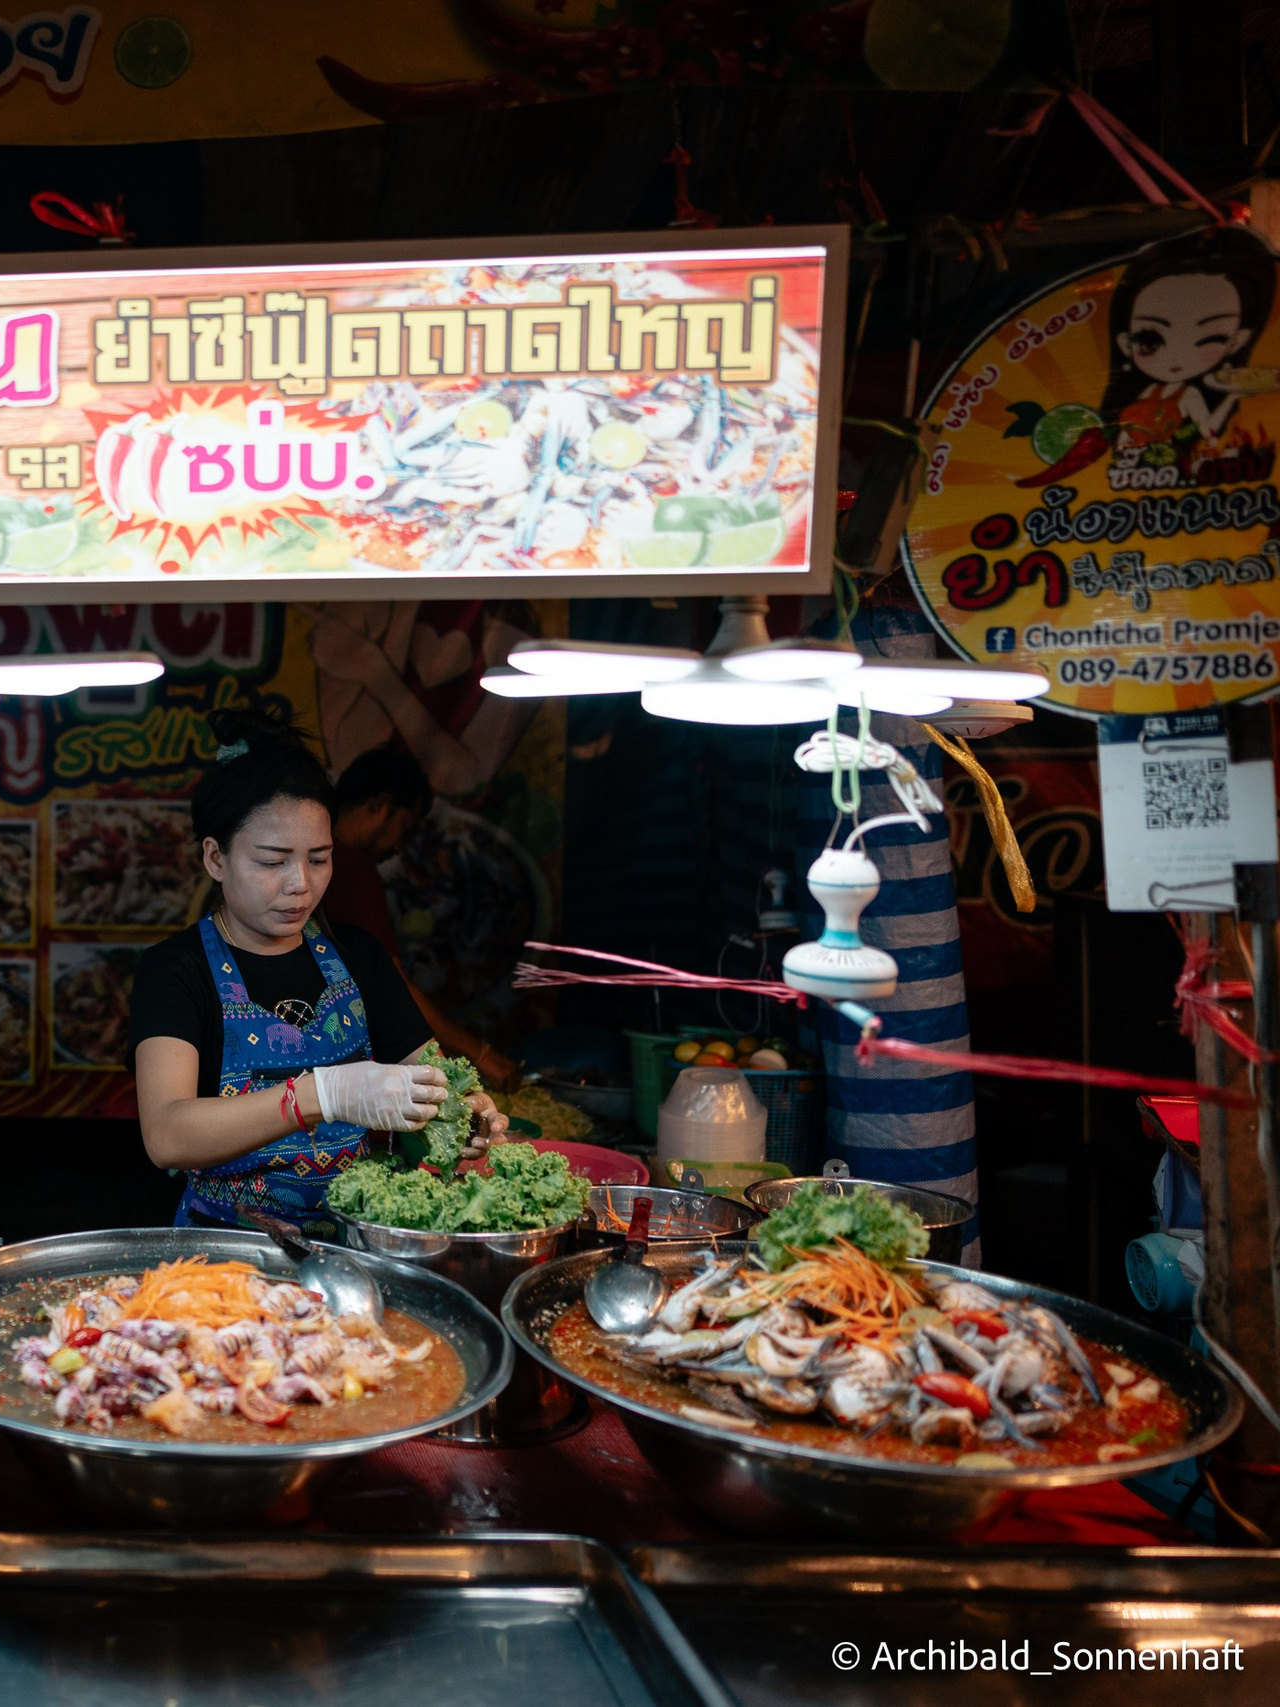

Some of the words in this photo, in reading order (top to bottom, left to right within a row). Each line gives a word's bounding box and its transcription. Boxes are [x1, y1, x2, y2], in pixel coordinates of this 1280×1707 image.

[1007, 300, 1096, 362] อร่อย
[9, 446, 80, 488] รส
[1026, 486, 1280, 546] น้องแนน
[943, 514, 1068, 610] ยำ
[1026, 621, 1161, 647] Chonticha
[1061, 653, 1273, 685] 089-4757886
